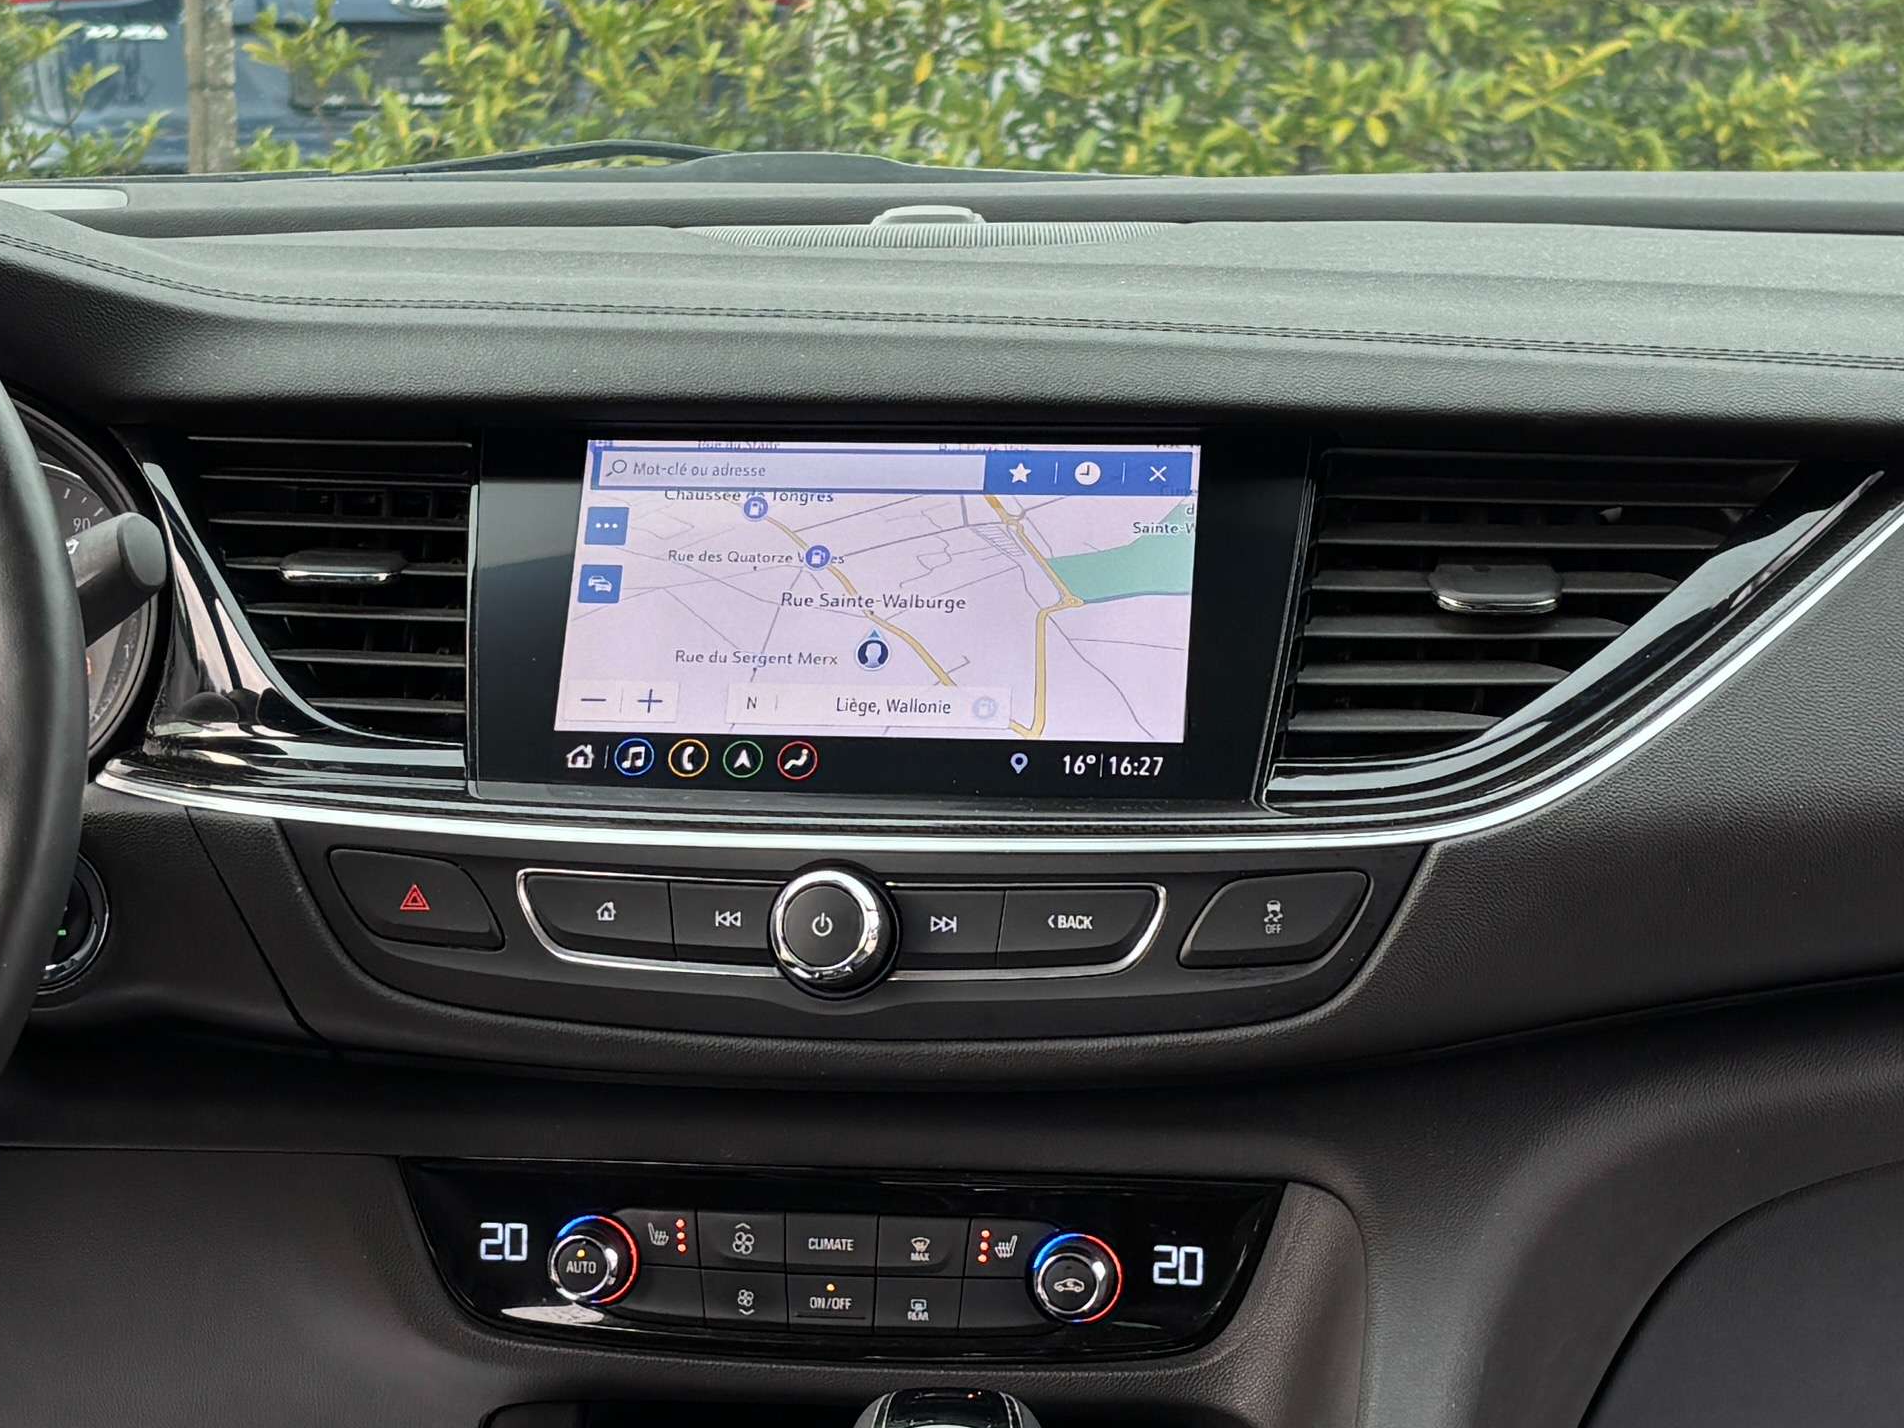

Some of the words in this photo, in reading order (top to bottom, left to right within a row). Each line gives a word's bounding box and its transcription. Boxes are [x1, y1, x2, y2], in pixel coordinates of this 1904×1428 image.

[633, 461, 688, 477] Mot-clé
[692, 465, 707, 477] ou
[712, 463, 766, 478] adresse
[668, 550, 694, 563] Rue
[698, 551, 722, 564] des
[727, 551, 793, 564] Quatorze
[780, 592, 814, 608] Rue
[819, 593, 967, 611] Sainte-Walburge
[675, 650, 705, 664] Rue
[708, 651, 727, 665] du
[732, 651, 793, 668] Sergent
[797, 652, 839, 666] Merx
[746, 696, 758, 710] N
[836, 696, 881, 715] Liège,
[887, 698, 952, 715] Wallonie
[1063, 754, 1096, 775] 16°
[1109, 756, 1164, 776] 16:27
[1057, 915, 1093, 930] BACK
[1265, 923, 1282, 935] OFF
[480, 1222, 528, 1262] 20
[808, 1237, 855, 1252] CLIMATE
[566, 1260, 597, 1274] AUTO
[1152, 1244, 1203, 1286] 20
[809, 1296, 853, 1310] ON/OFF
